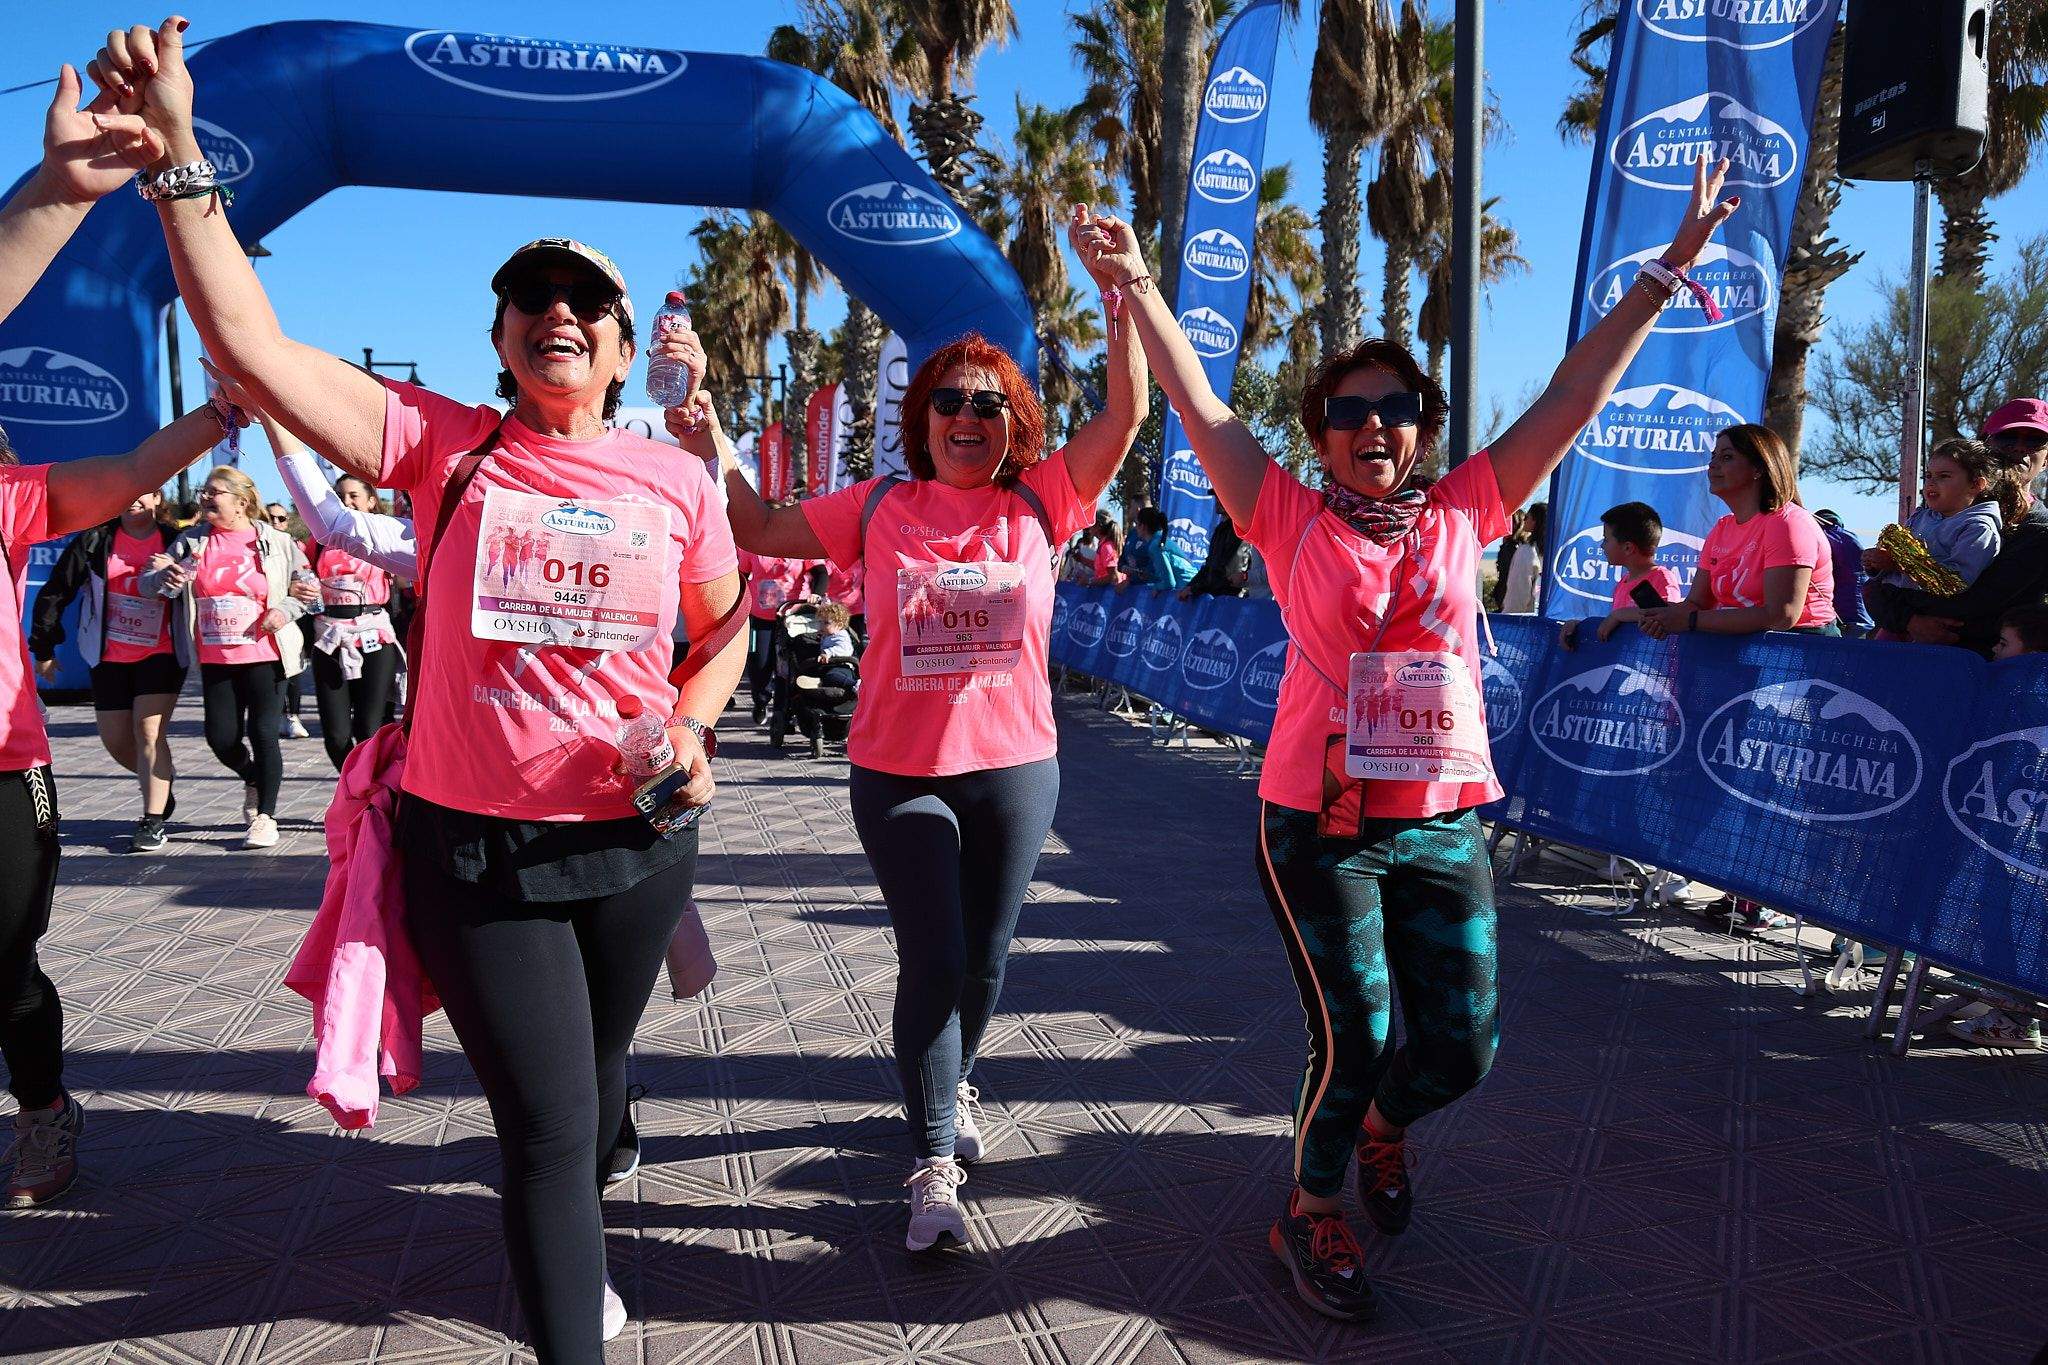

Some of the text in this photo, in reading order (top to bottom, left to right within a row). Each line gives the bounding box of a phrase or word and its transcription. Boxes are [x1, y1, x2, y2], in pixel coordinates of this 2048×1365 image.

[427, 33, 668, 74] ASTURIANA
[1658, 125, 1780, 149] CENTRAL LECHERA
[1623, 131, 1781, 177] ASTURIANA
[1198, 166, 1250, 192] ASTURIANA
[839, 204, 954, 230] ASTURIANA
[1187, 243, 1244, 272] ASTURIANA
[1697, 271, 1756, 280] LECHERA
[0, 382, 117, 411] TURIANA
[881, 356, 909, 479] YSHO
[1610, 412, 1732, 427] CENTRAL LECHERA
[815, 405, 829, 481] Santander
[1580, 415, 1719, 453] ASTURIAN
[546, 513, 610, 532] ASTURIANA
[543, 558, 610, 588] 016
[939, 576, 984, 587] ASTURIANA
[554, 591, 586, 604] 9445
[499, 601, 639, 622] CARRERA DE LA MUJER VALENCIA
[943, 609, 989, 629] 016
[119, 616, 142, 627] 016
[215, 617, 237, 627] 016
[494, 618, 551, 634] OYSHO
[587, 629, 639, 643] Santander
[916, 645, 944, 654] CARRERA
[953, 644, 960, 652] LA
[961, 643, 981, 652] MUJER
[986, 642, 1012, 650] VALENCIA
[915, 657, 955, 669] OYSHO
[978, 657, 1014, 666] Santander
[895, 677, 944, 692] CARRERA
[947, 677, 960, 691] DE
[964, 676, 976, 690] LA
[1400, 670, 1450, 682] ASTURIANA
[473, 684, 543, 712] CARRERA
[571, 697, 591, 717] LA
[1569, 699, 1613, 713] CENTRAL
[1400, 709, 1454, 731] 016
[1539, 699, 1668, 755] ASTURIANA
[1413, 735, 1434, 745] 960
[1747, 718, 1899, 754] CENTRAL LECHERA
[1366, 748, 1397, 756] CARRERA
[1398, 748, 1408, 756] DE
[1708, 718, 1895, 799] ASTURIANA
[1363, 761, 1410, 773] OYSHO
